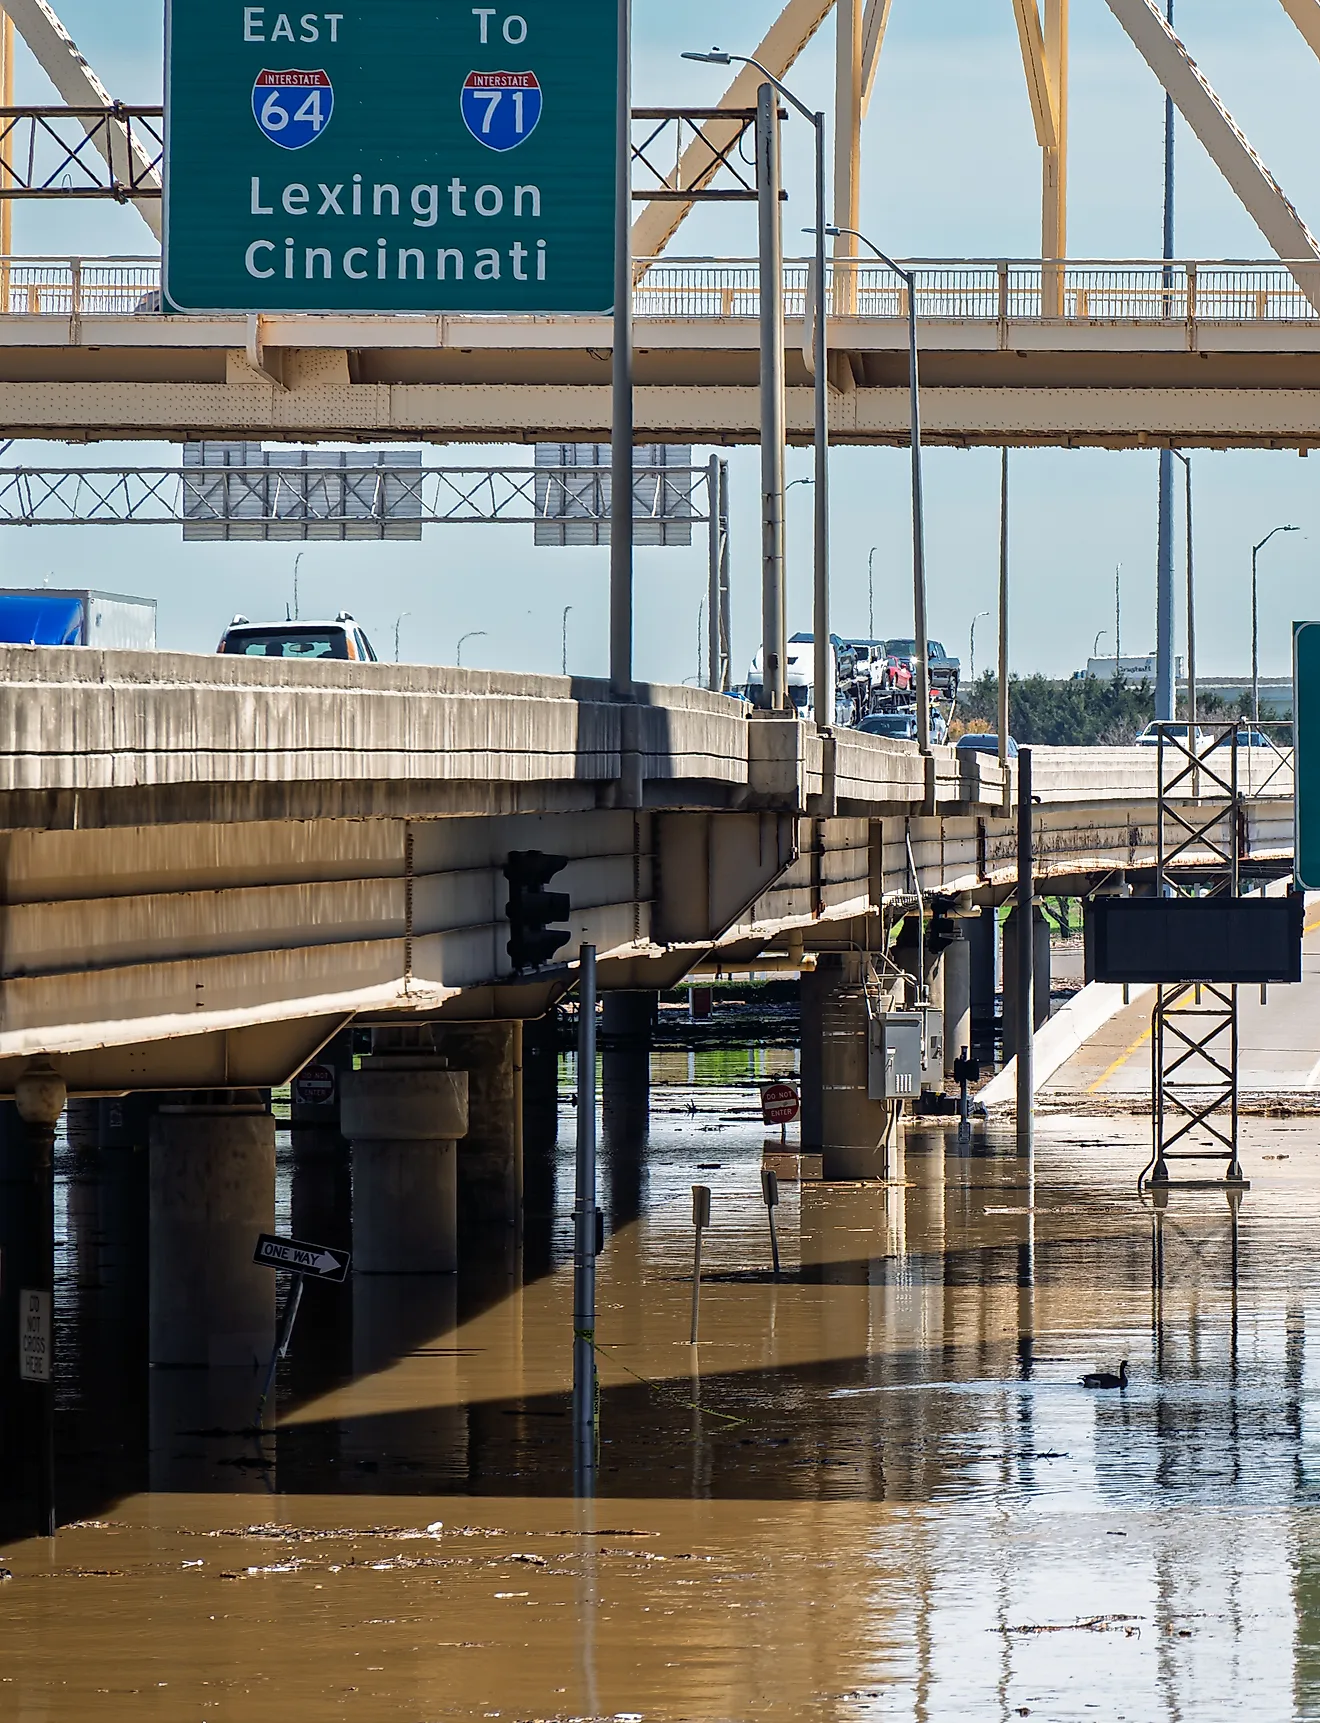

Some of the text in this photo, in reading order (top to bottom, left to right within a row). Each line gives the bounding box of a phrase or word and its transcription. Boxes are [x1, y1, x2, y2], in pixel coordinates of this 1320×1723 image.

[243, 6, 344, 42] EAST
[264, 74, 321, 86] INTERSTATE
[473, 75, 529, 87] INTERSTATE
[261, 90, 324, 131] 64
[473, 91, 523, 133] 71
[250, 173, 541, 227] Lexington
[245, 237, 547, 281] Cincinnati
[766, 1090, 792, 1101] DO NOT
[771, 1108, 792, 1117] ENTER
[264, 1243, 319, 1265] ONE WAY
[29, 1295, 40, 1313] DO
[26, 1316, 41, 1333] NOT
[23, 1334, 45, 1354] CROSS
